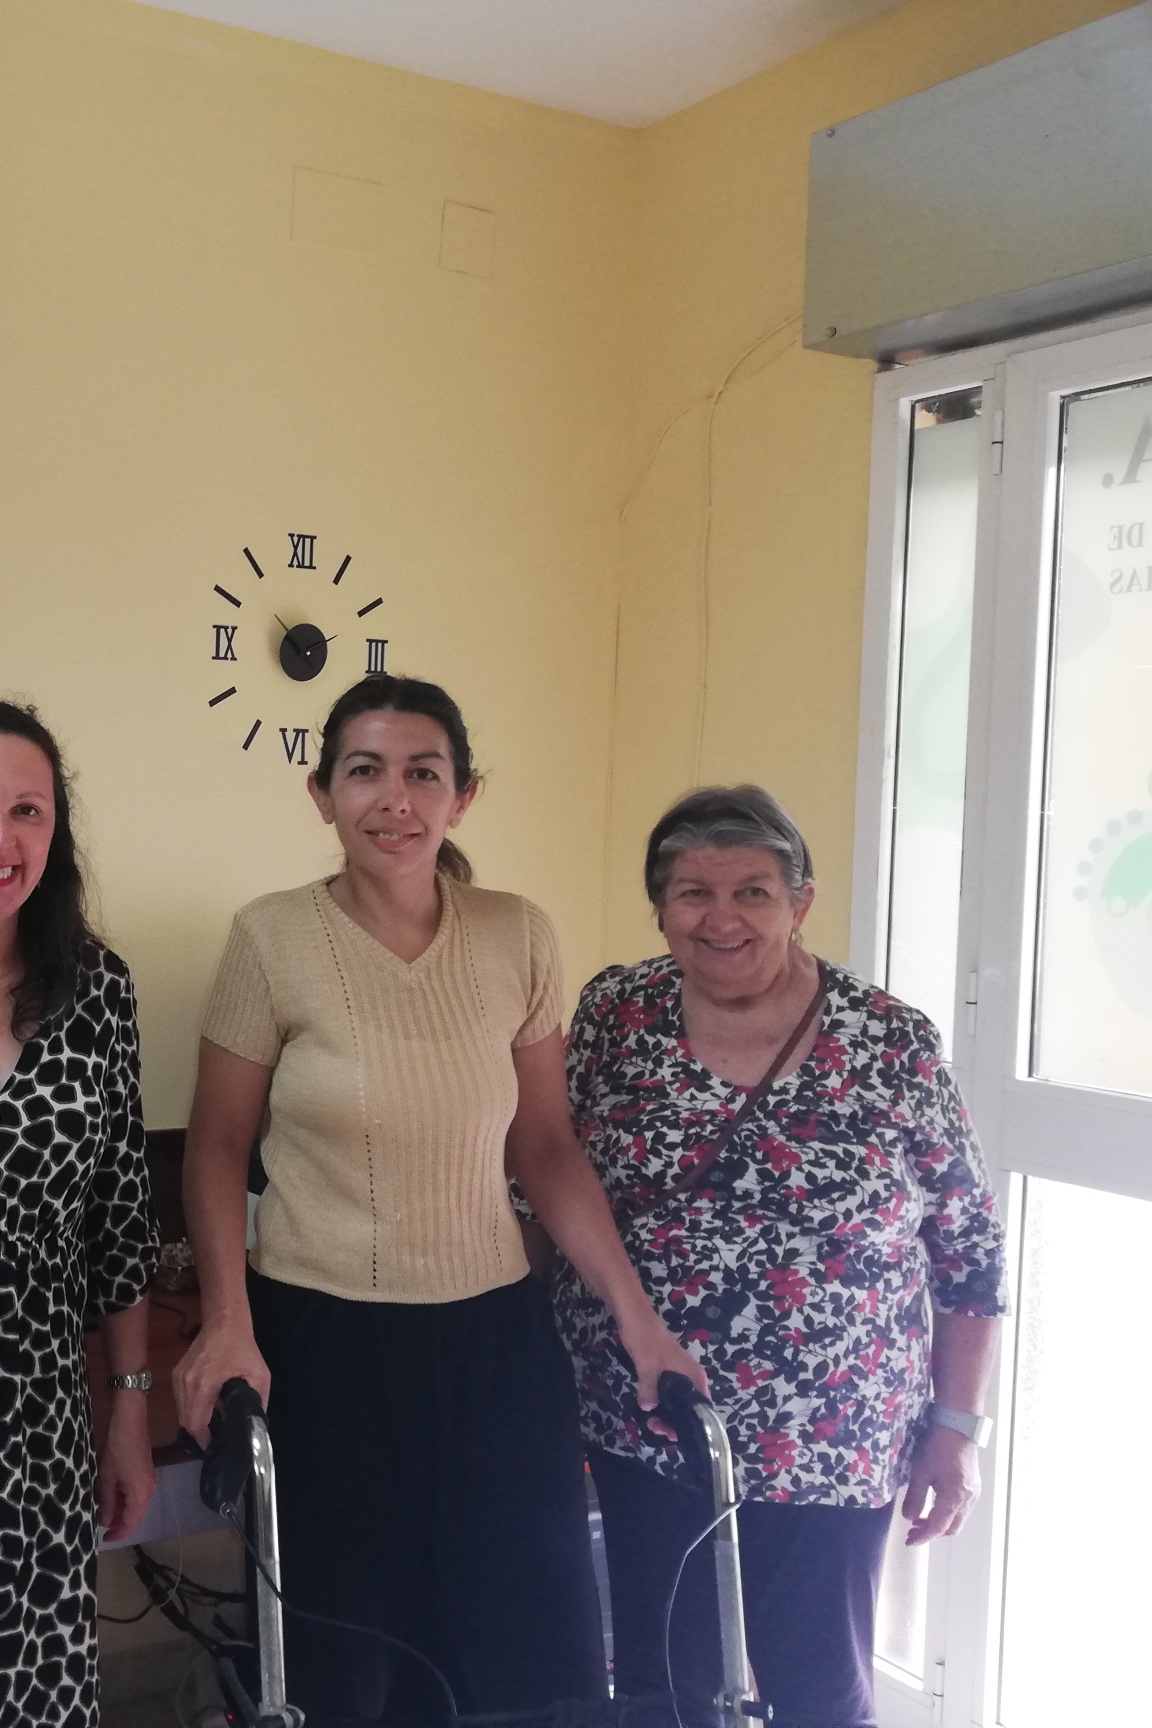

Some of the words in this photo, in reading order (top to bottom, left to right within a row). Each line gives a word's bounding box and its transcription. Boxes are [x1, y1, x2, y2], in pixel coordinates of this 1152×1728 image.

[288, 533, 317, 570] XII
[212, 624, 238, 661] IX
[365, 638, 389, 674] III
[279, 728, 310, 765] VI
